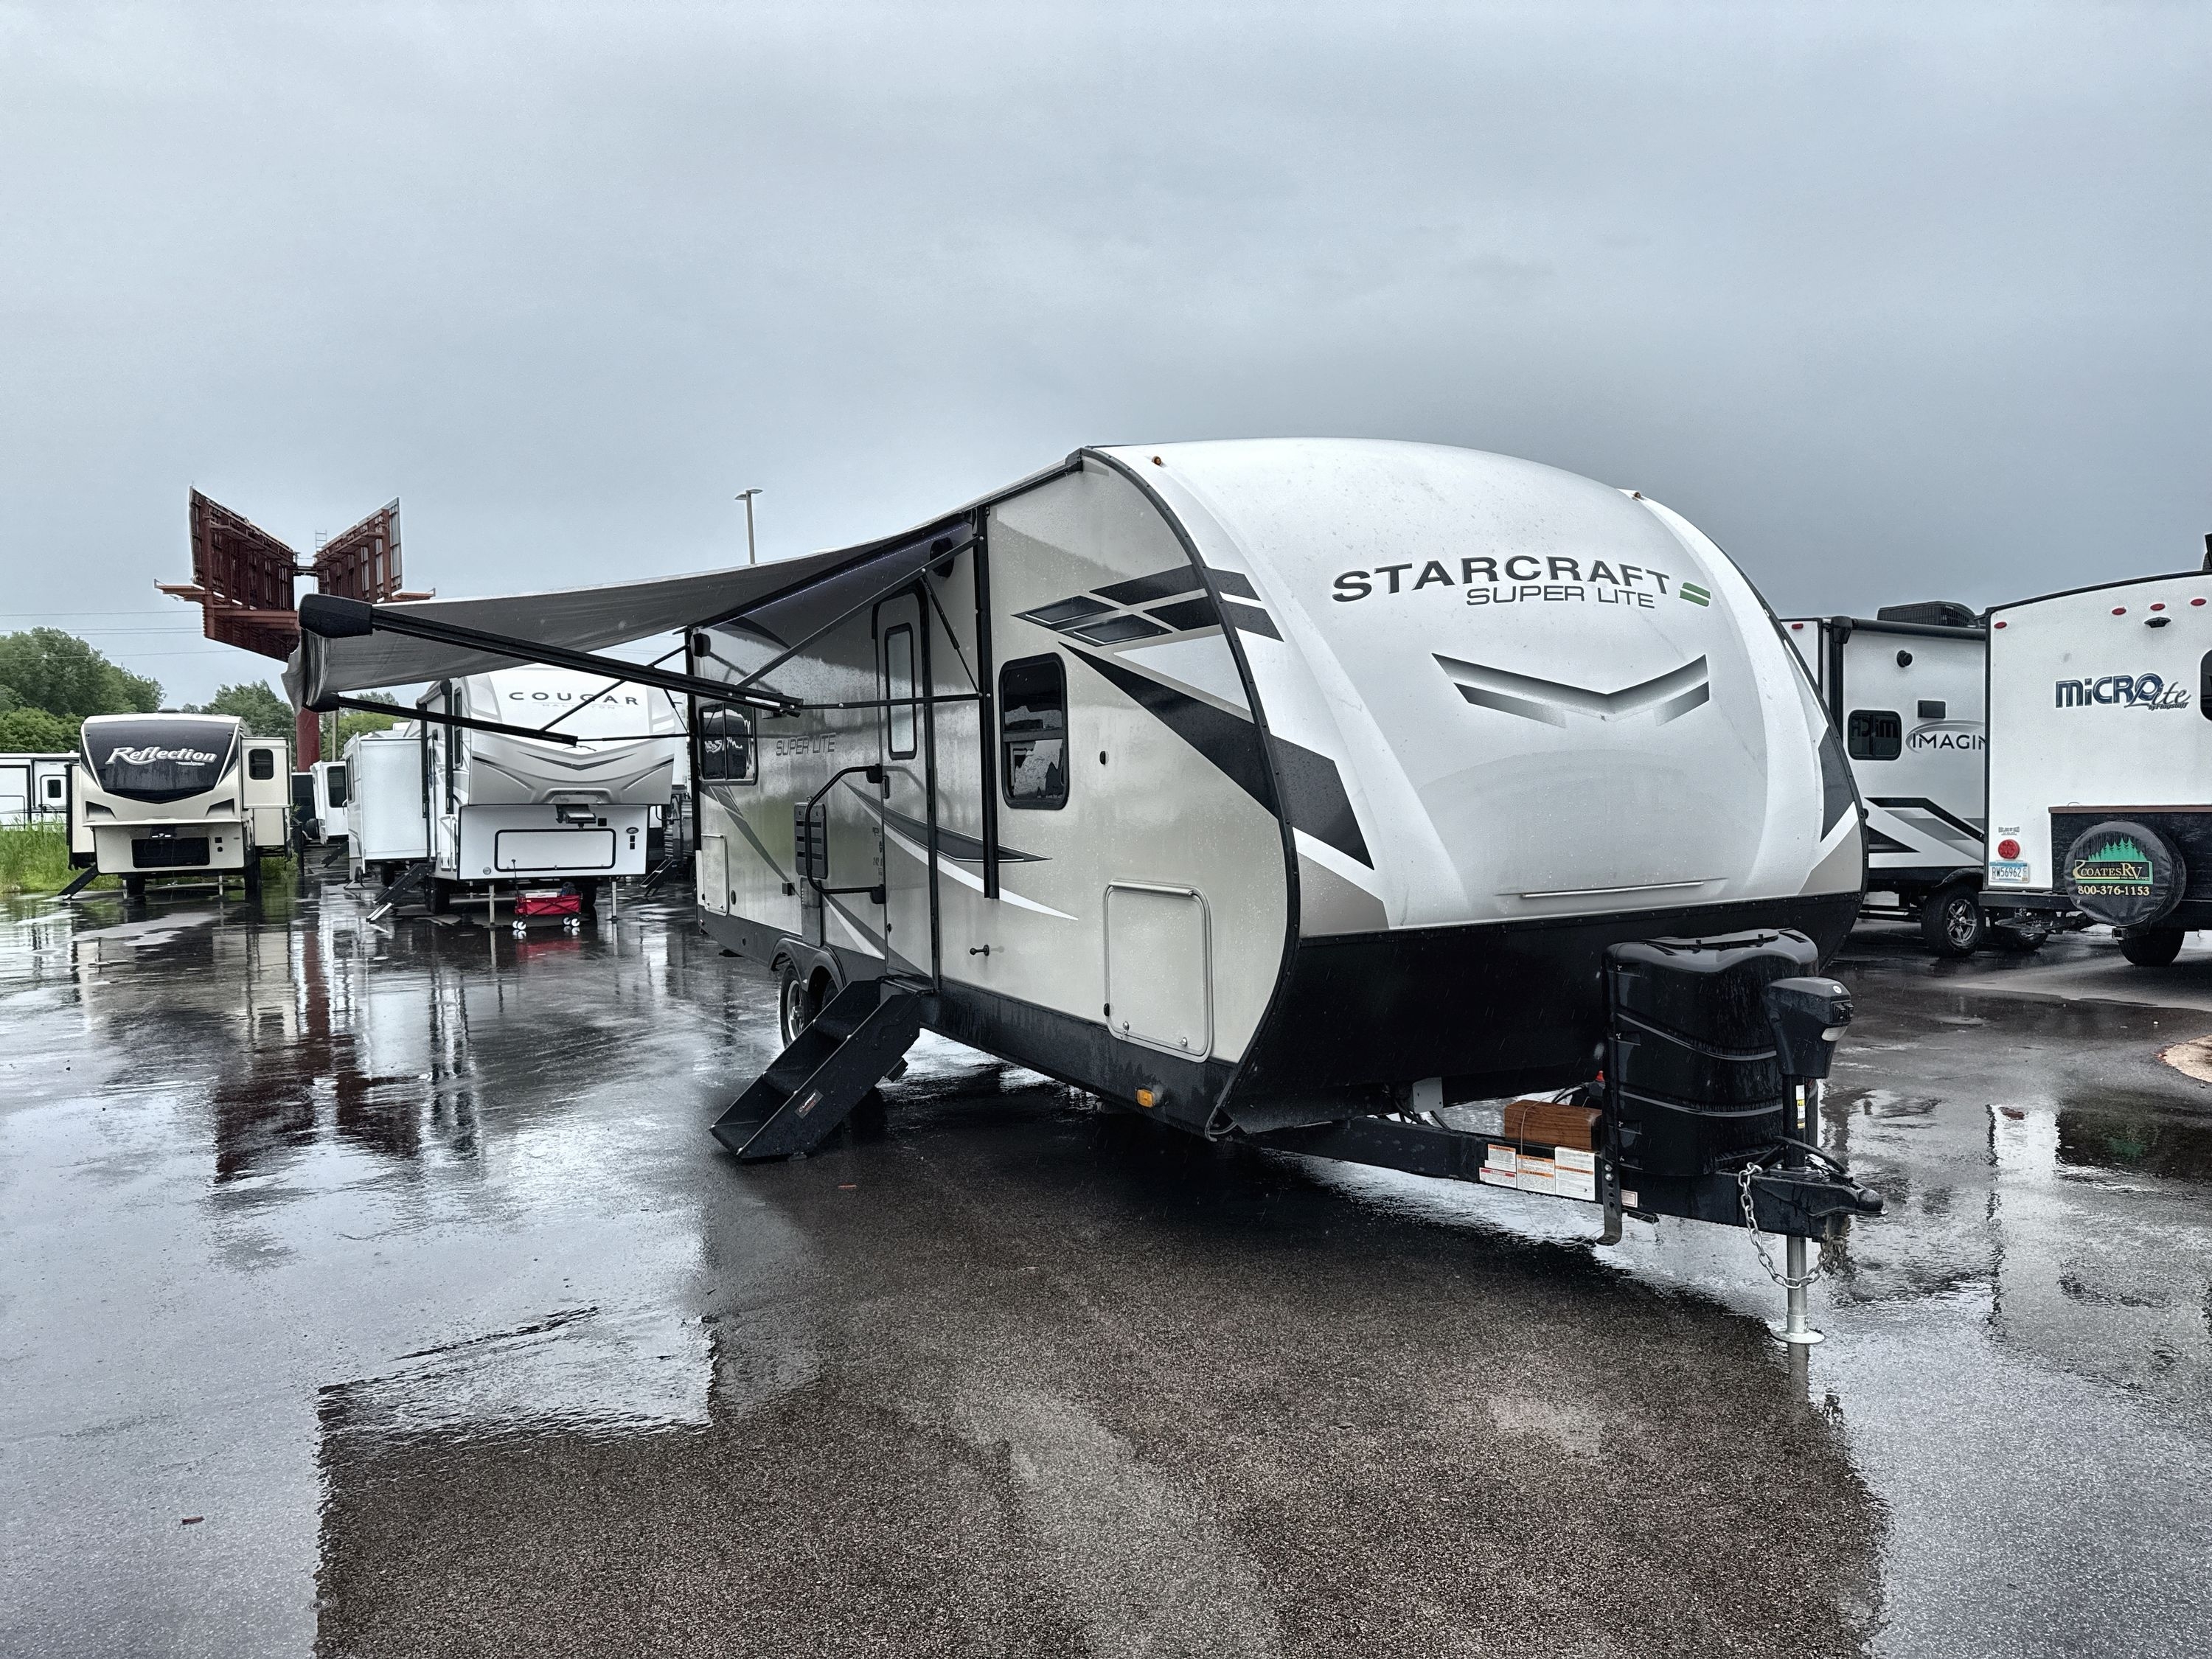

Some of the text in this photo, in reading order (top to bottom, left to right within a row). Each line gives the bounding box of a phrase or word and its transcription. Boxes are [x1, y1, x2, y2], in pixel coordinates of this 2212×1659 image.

[1332, 555, 1670, 602] STARCRAFT
[1466, 585, 1655, 610] SUPER LITE
[508, 692, 639, 706] COUGAR
[776, 734, 836, 756] SUPER LITE
[105, 746, 218, 765] Reflection
[2077, 885, 2150, 896] 800-376-1153
